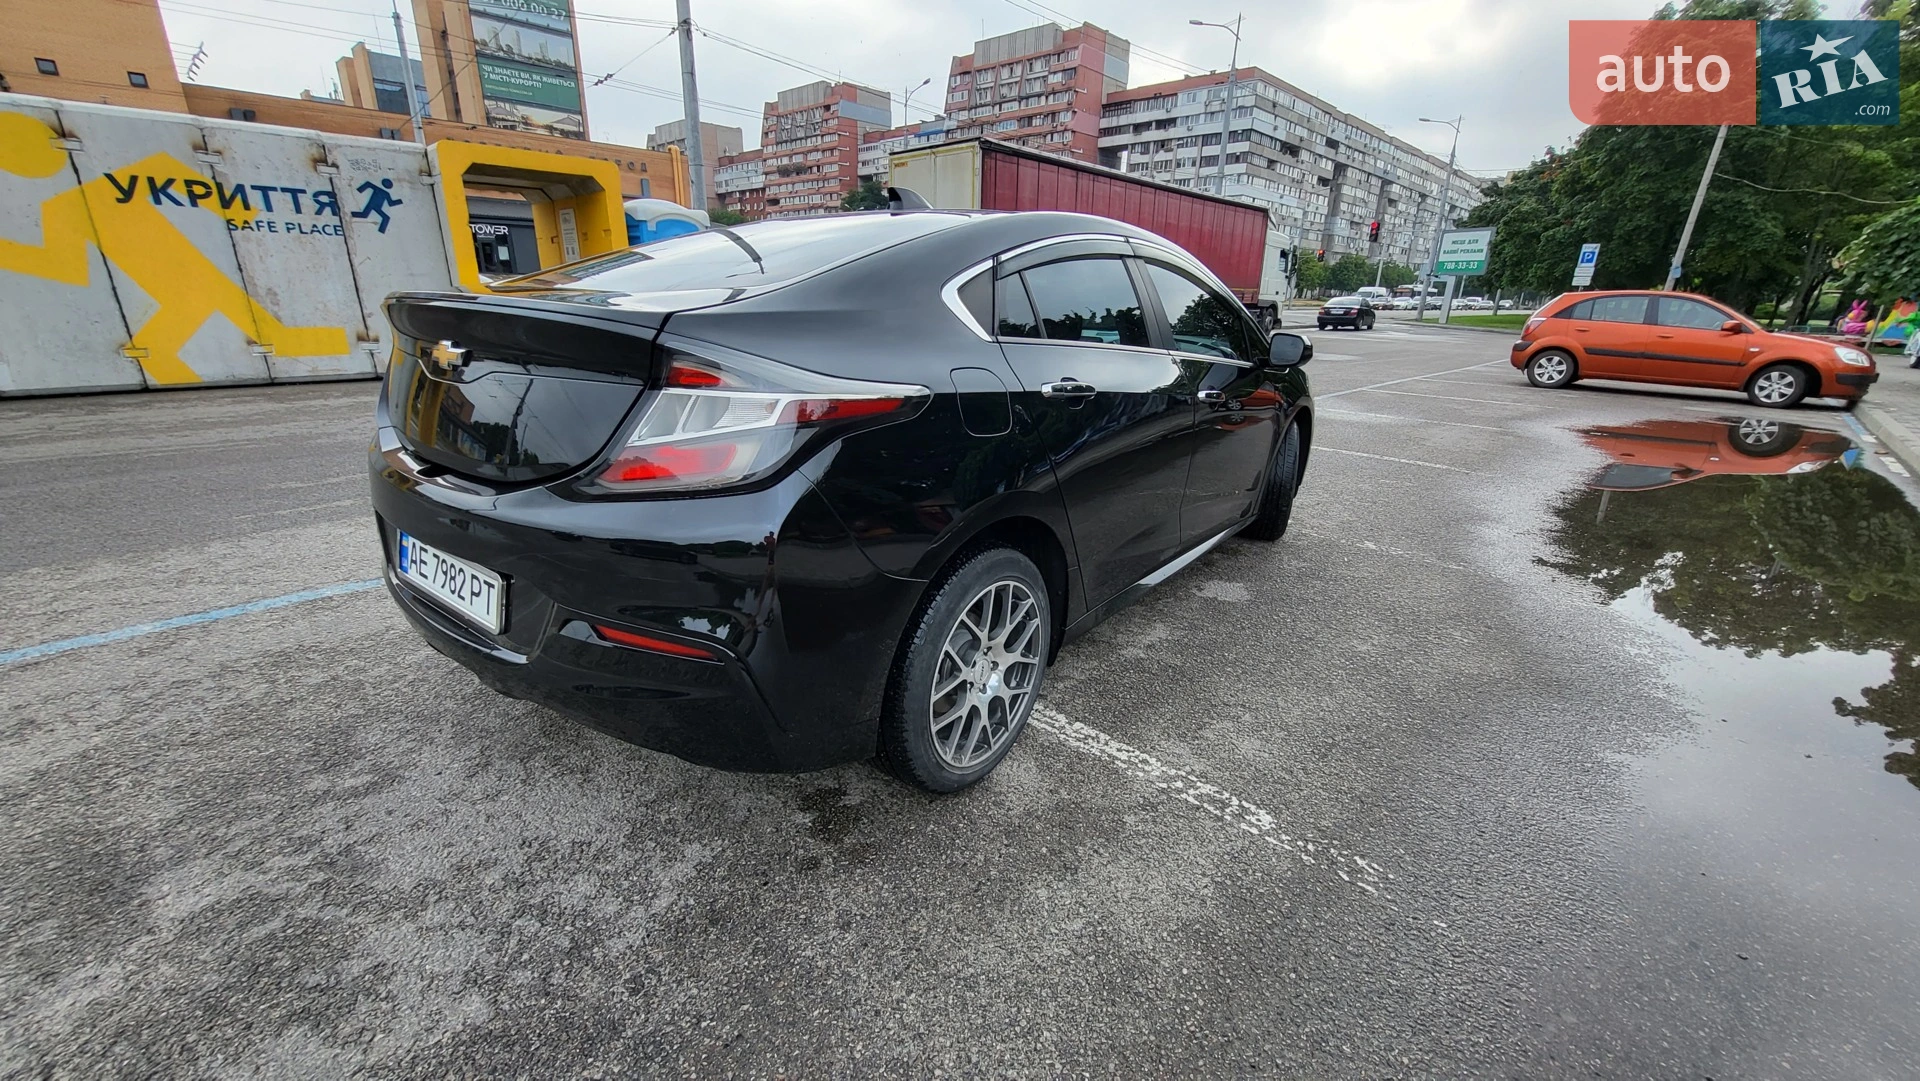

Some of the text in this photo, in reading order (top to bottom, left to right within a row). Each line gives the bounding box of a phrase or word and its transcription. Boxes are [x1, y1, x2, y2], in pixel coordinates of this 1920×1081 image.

[482, 64, 493, 73] ЧИ
[520, 71, 532, 80] ВИ,
[532, 74, 541, 82] ЯК
[541, 76, 576, 88] ЖИВЕТЬСЯ
[489, 73, 542, 89] МІСТІ-КУРОРТІ?
[103, 172, 339, 217] УКРИТТЯ
[227, 218, 344, 236] SAFE PLACE
[470, 223, 509, 235] TOWER
[1583, 252, 1592, 263] P
[409, 541, 495, 616] AE 7982 PT
